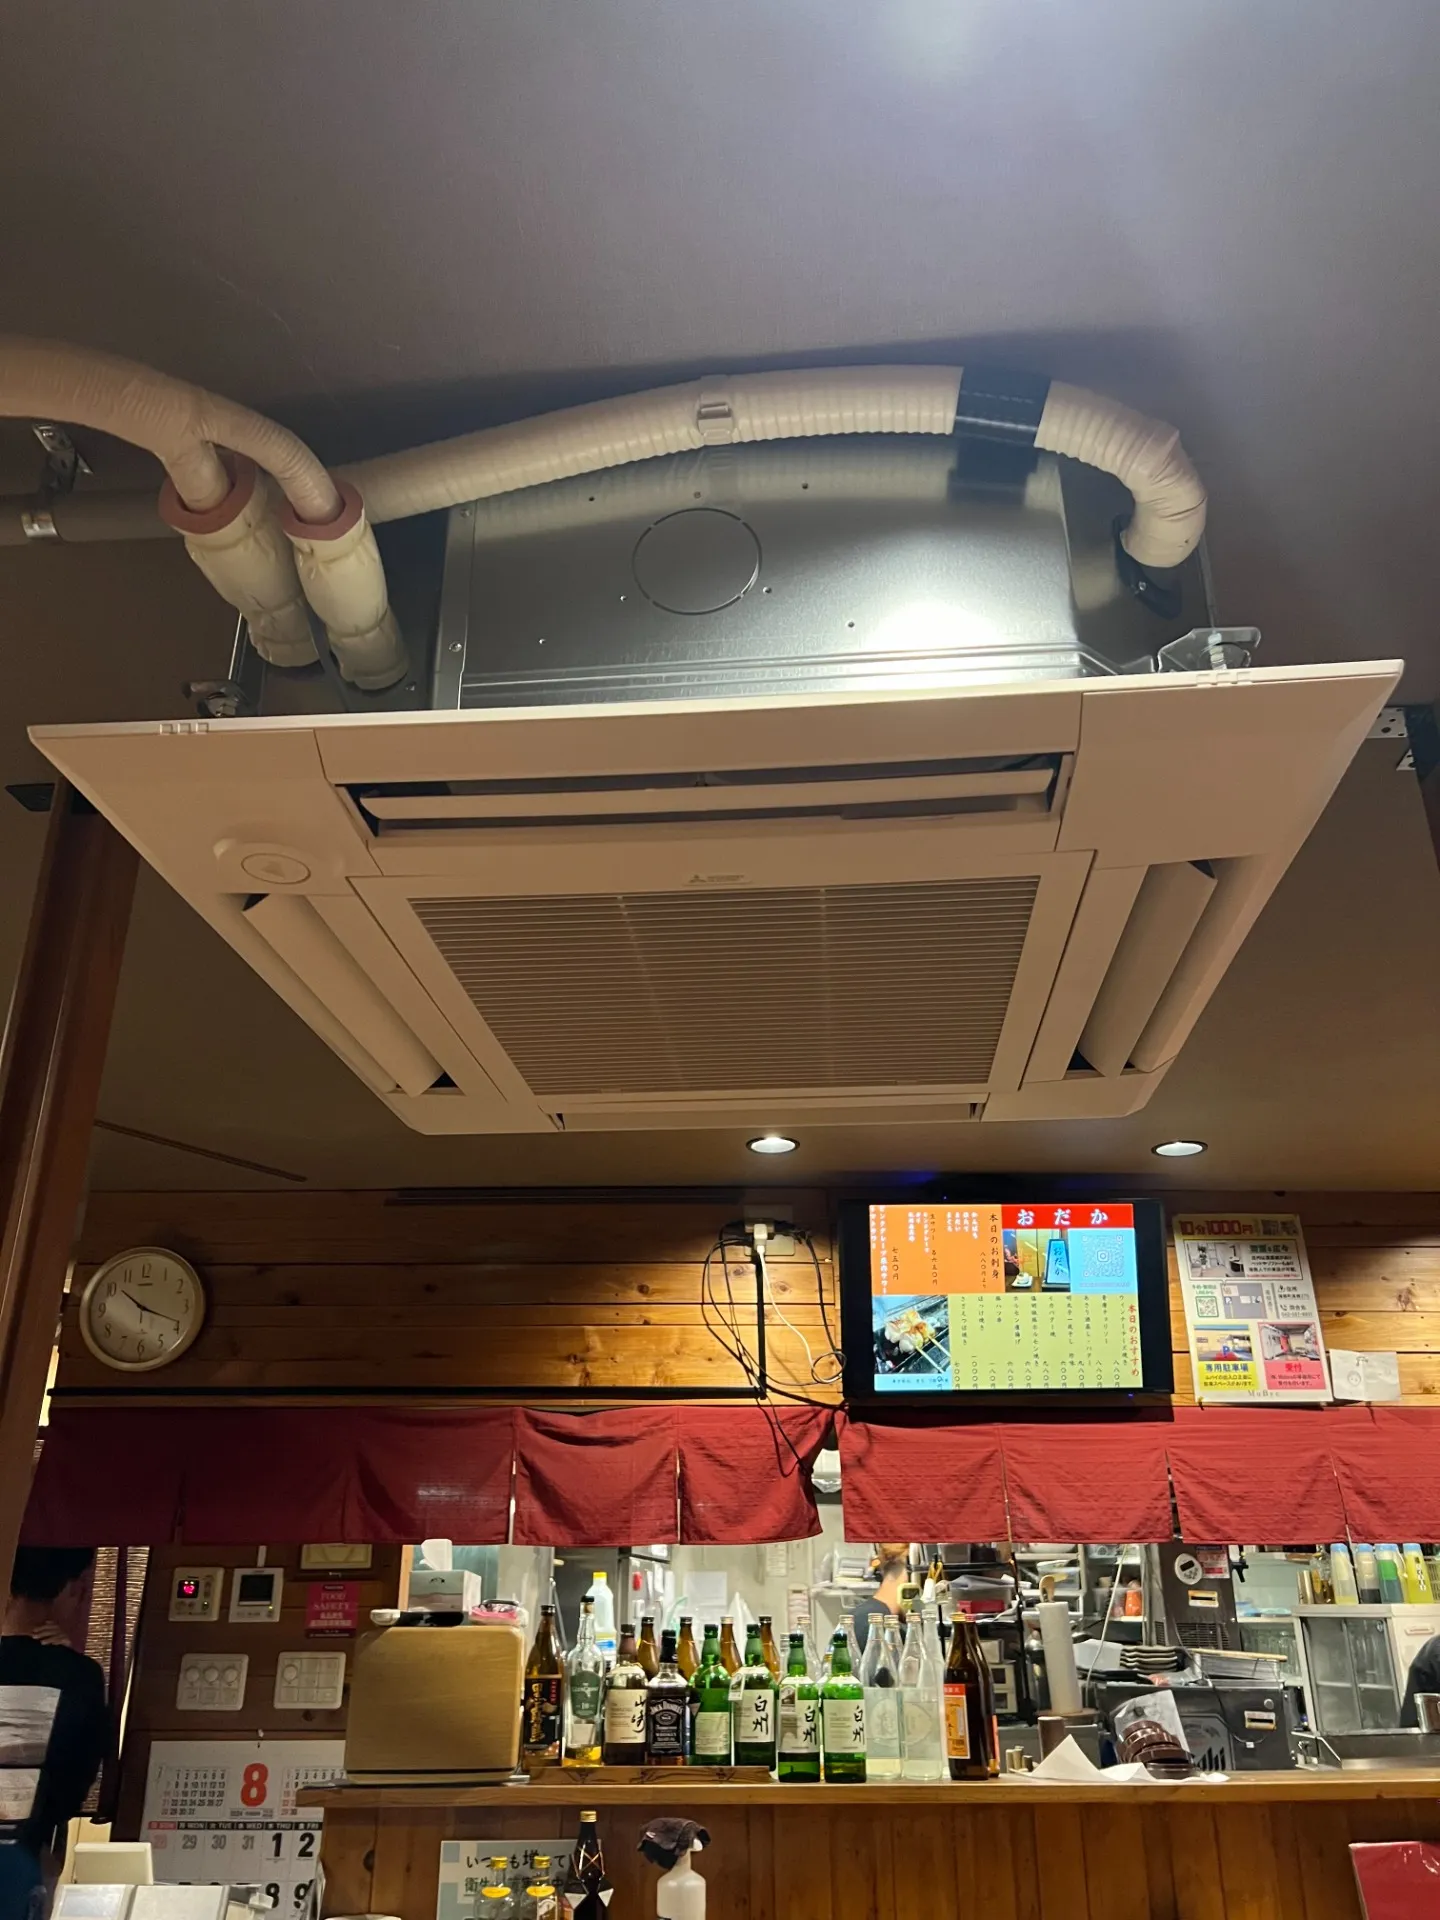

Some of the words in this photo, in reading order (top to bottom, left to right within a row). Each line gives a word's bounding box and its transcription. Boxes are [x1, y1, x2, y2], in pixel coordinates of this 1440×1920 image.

[1017, 1208, 1108, 1226] おだか
[989, 1212, 999, 1279] 本日のお刺身
[1053, 1247, 1064, 1276] おだか
[1128, 1304, 1140, 1377] 本日のおすすめ
[1205, 1363, 1249, 1372] 専用駐車場
[1285, 1363, 1302, 1372] 受付
[752, 1695, 769, 1736] 白州
[803, 1704, 817, 1745] 白州
[853, 1704, 865, 1745] 白州
[241, 1763, 269, 1807] 8
[182, 1835, 197, 1849] 29
[212, 1835, 227, 1850] 30
[242, 1835, 254, 1850] 31
[272, 1833, 283, 1857] 1
[298, 1833, 315, 1857] 2
[266, 1883, 280, 1909] 8
